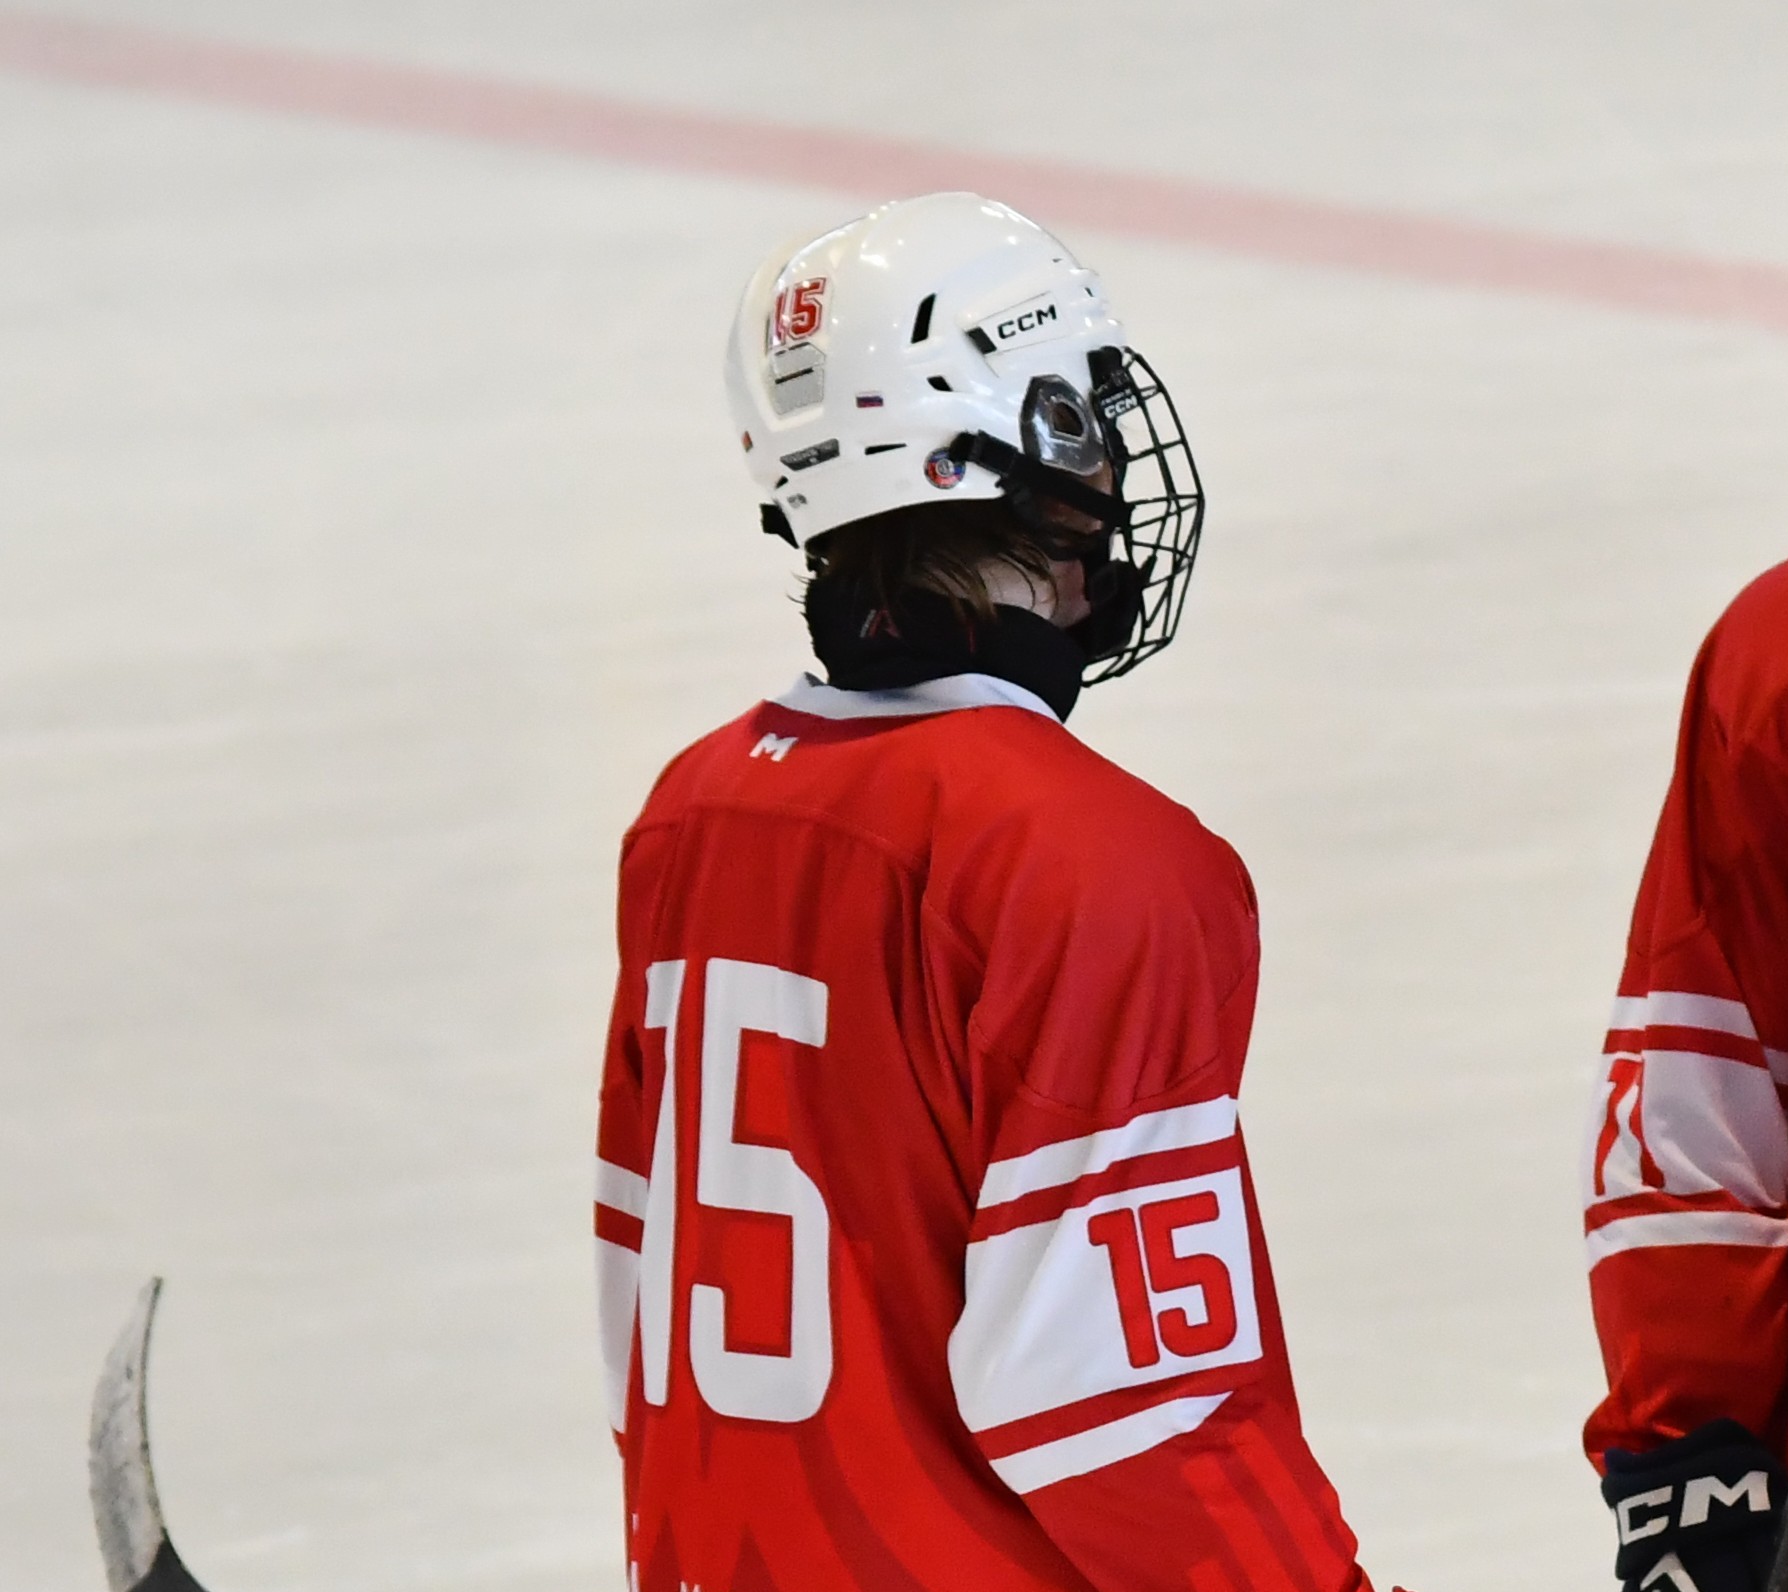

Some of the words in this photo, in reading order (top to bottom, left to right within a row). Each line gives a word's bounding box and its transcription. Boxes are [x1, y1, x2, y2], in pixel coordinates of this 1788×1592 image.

[775, 277, 827, 346] 15
[997, 304, 1058, 340] CCM
[639, 957, 834, 1423] 15
[1087, 1190, 1237, 1370] 15
[1617, 1470, 1771, 1547] CM
